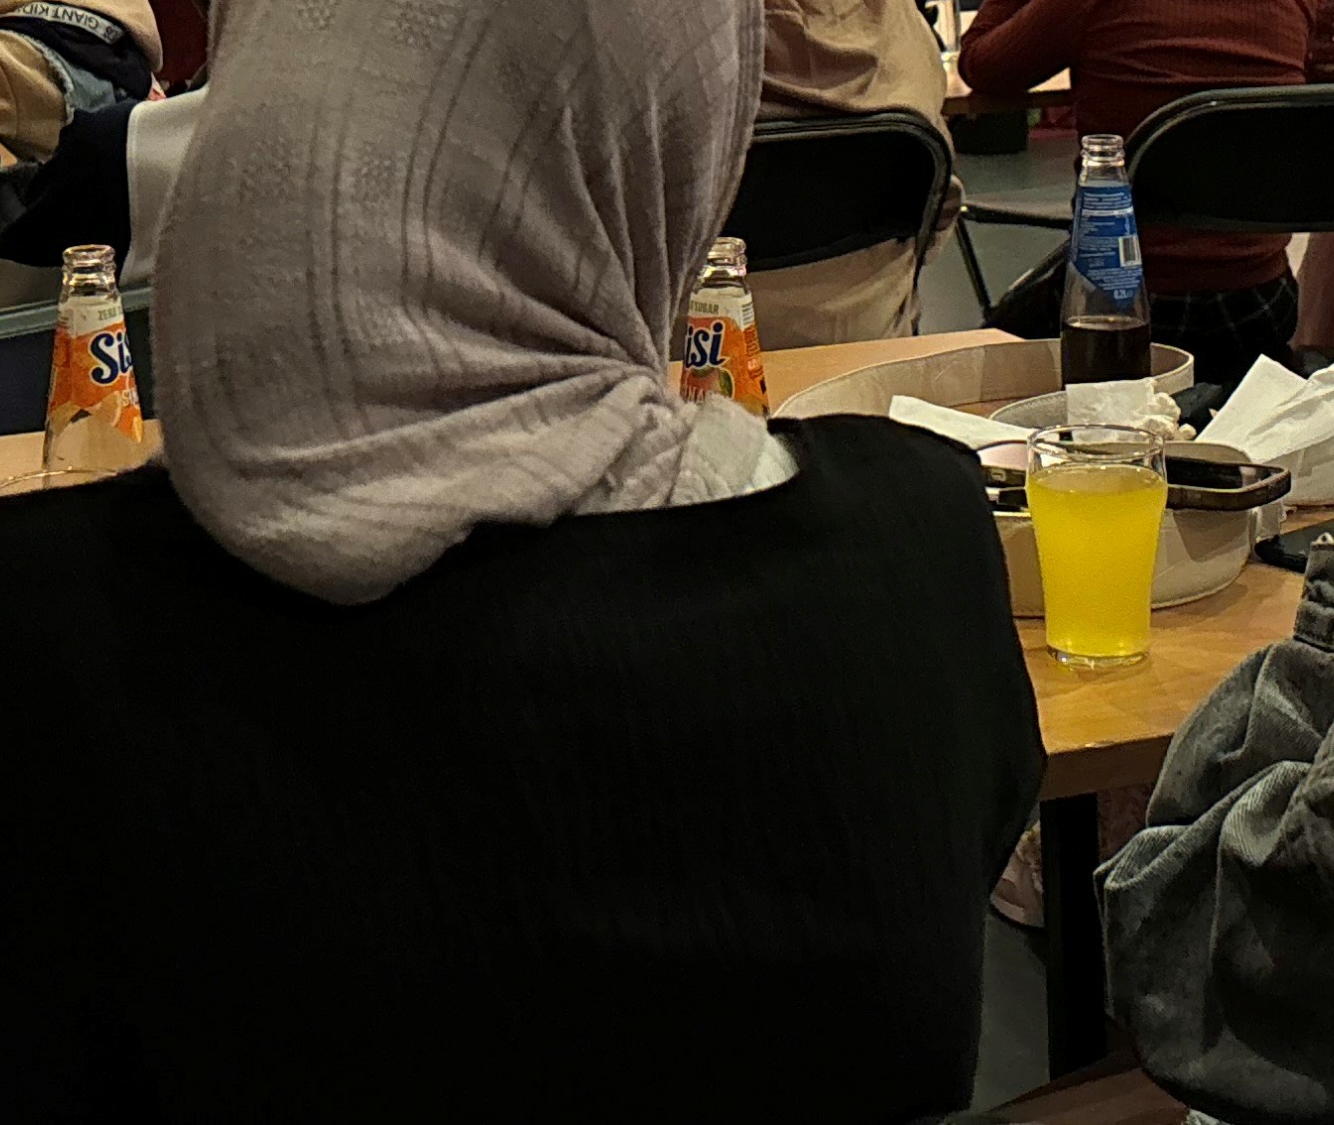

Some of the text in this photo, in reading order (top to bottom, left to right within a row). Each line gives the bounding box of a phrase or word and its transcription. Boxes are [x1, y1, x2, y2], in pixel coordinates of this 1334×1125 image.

[51, 7, 100, 30] GIANT
[90, 331, 134, 384] Si
[685, 322, 727, 368] isi
